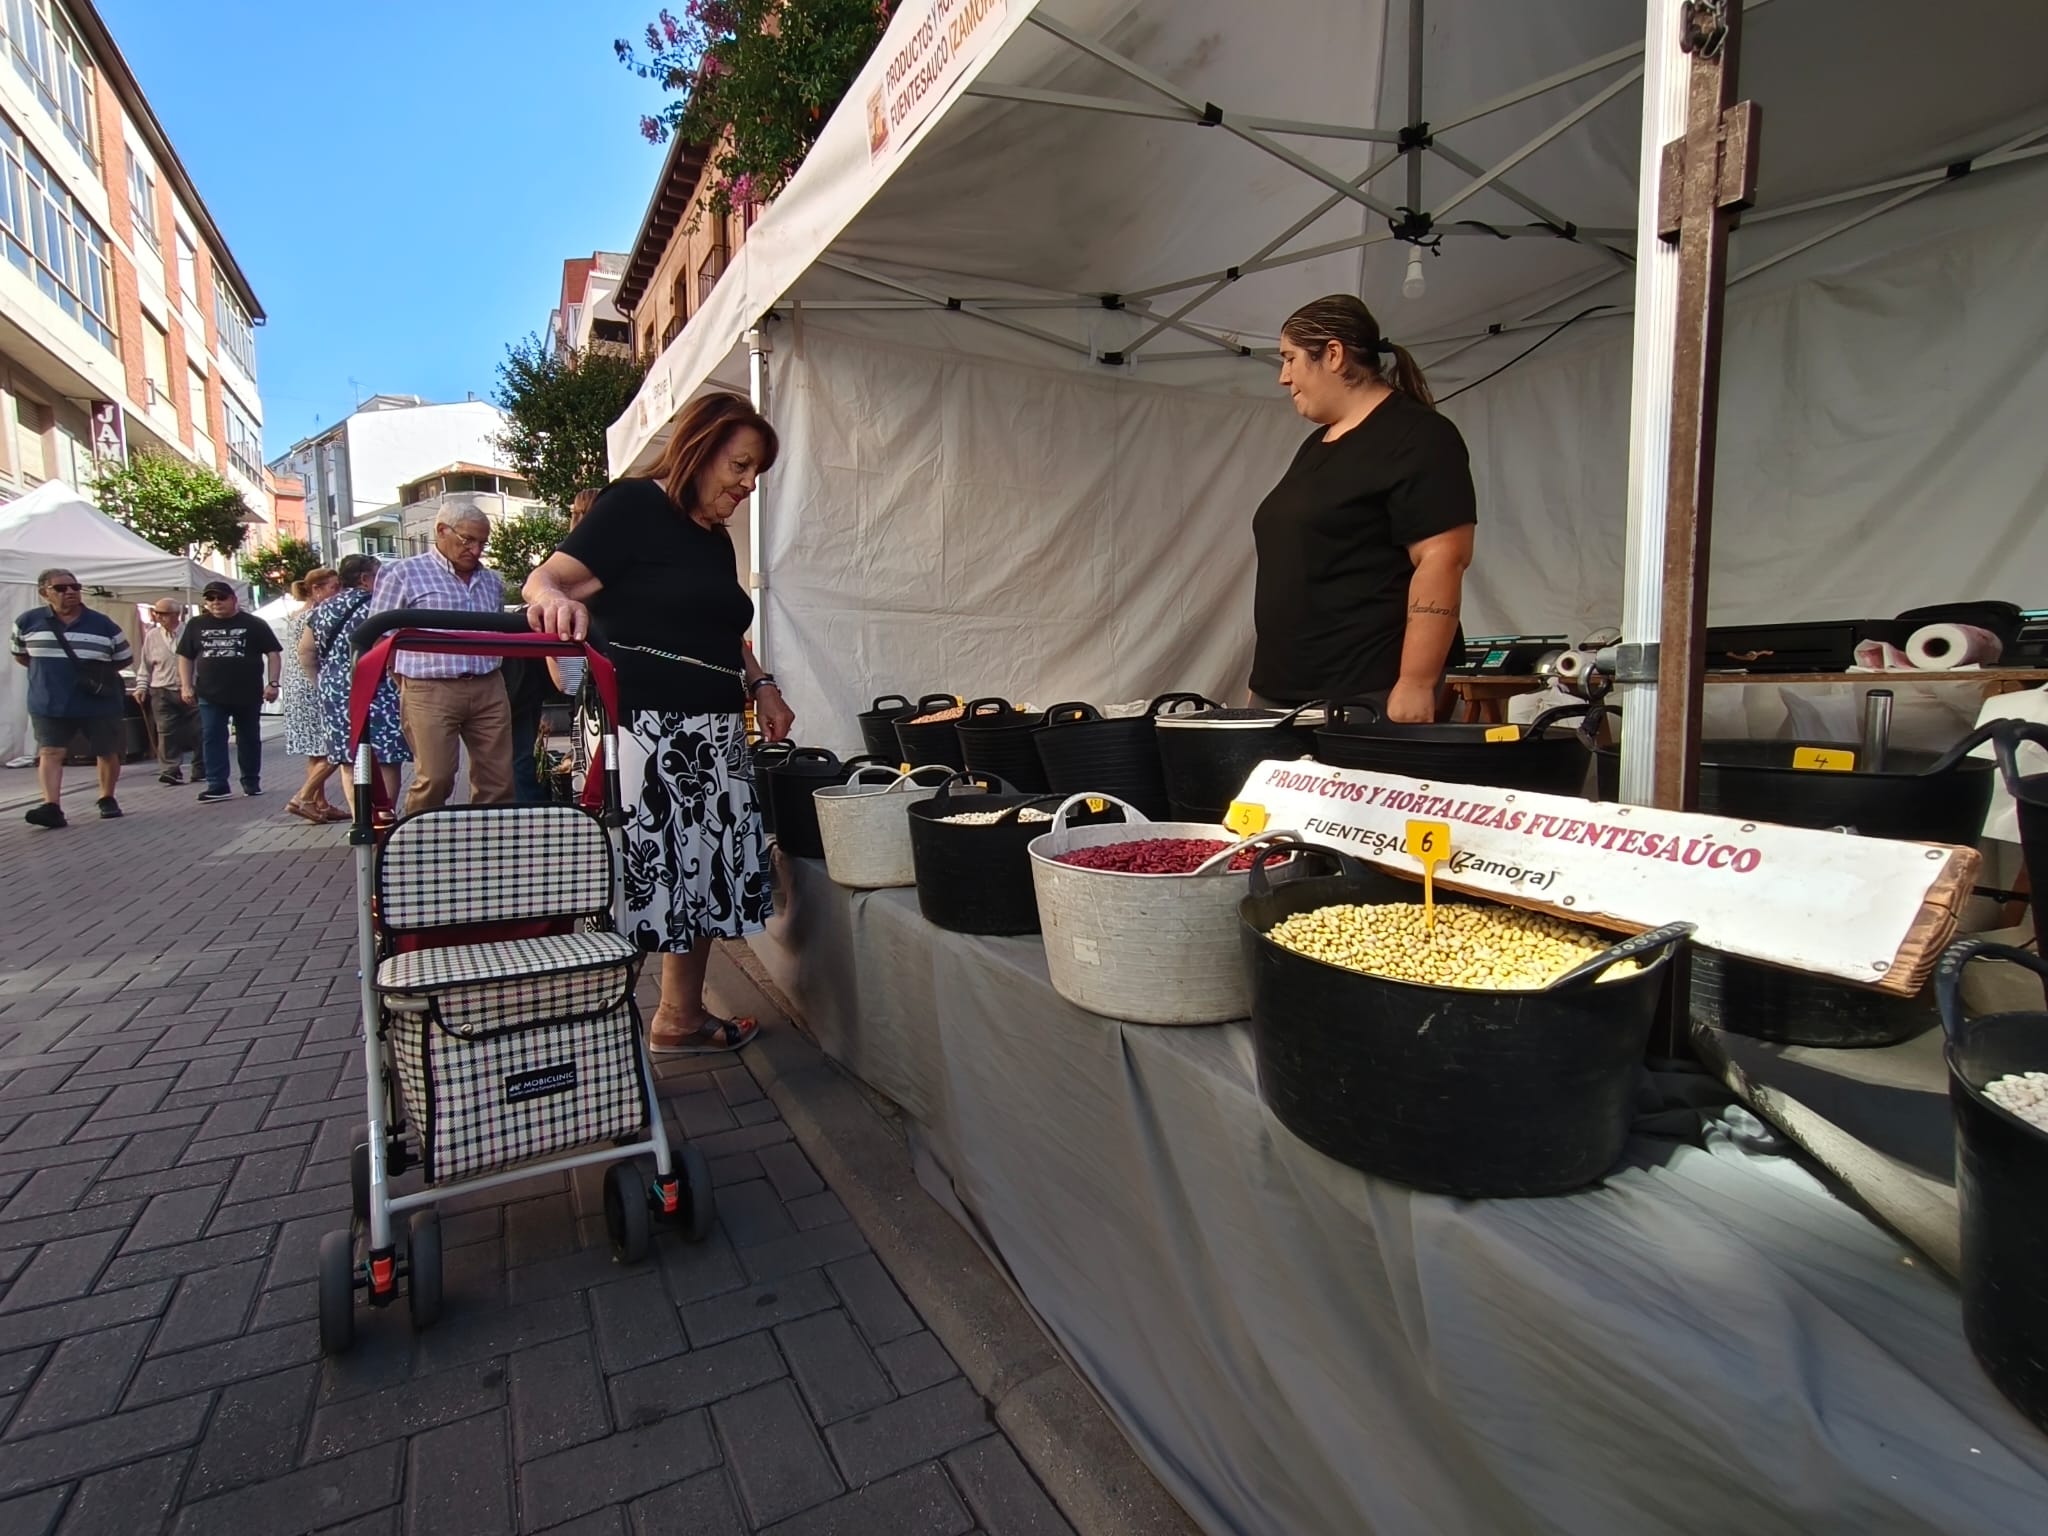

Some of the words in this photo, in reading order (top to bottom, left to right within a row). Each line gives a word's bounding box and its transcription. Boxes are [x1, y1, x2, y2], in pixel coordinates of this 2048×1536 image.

[886, 14, 933, 97] PRODUCTOS
[931, 1, 937, 31] Y
[890, 35, 948, 133] FUENTESAUCO
[949, 0, 1002, 59] (ZAMO
[1813, 753, 1829, 769] 4
[1241, 809, 1250, 825] 5
[1265, 769, 1369, 802] PRODUCTOS
[1366, 786, 1387, 805] Y
[1379, 789, 1527, 831] HORTALIZAS
[1523, 813, 1762, 873] FUENTESAÚCO
[1304, 818, 1409, 854] FUENTESA
[1449, 850, 1556, 891] (Zamora)
[1421, 831, 1434, 853] 6
[523, 1071, 574, 1089] MOBICLINIC
